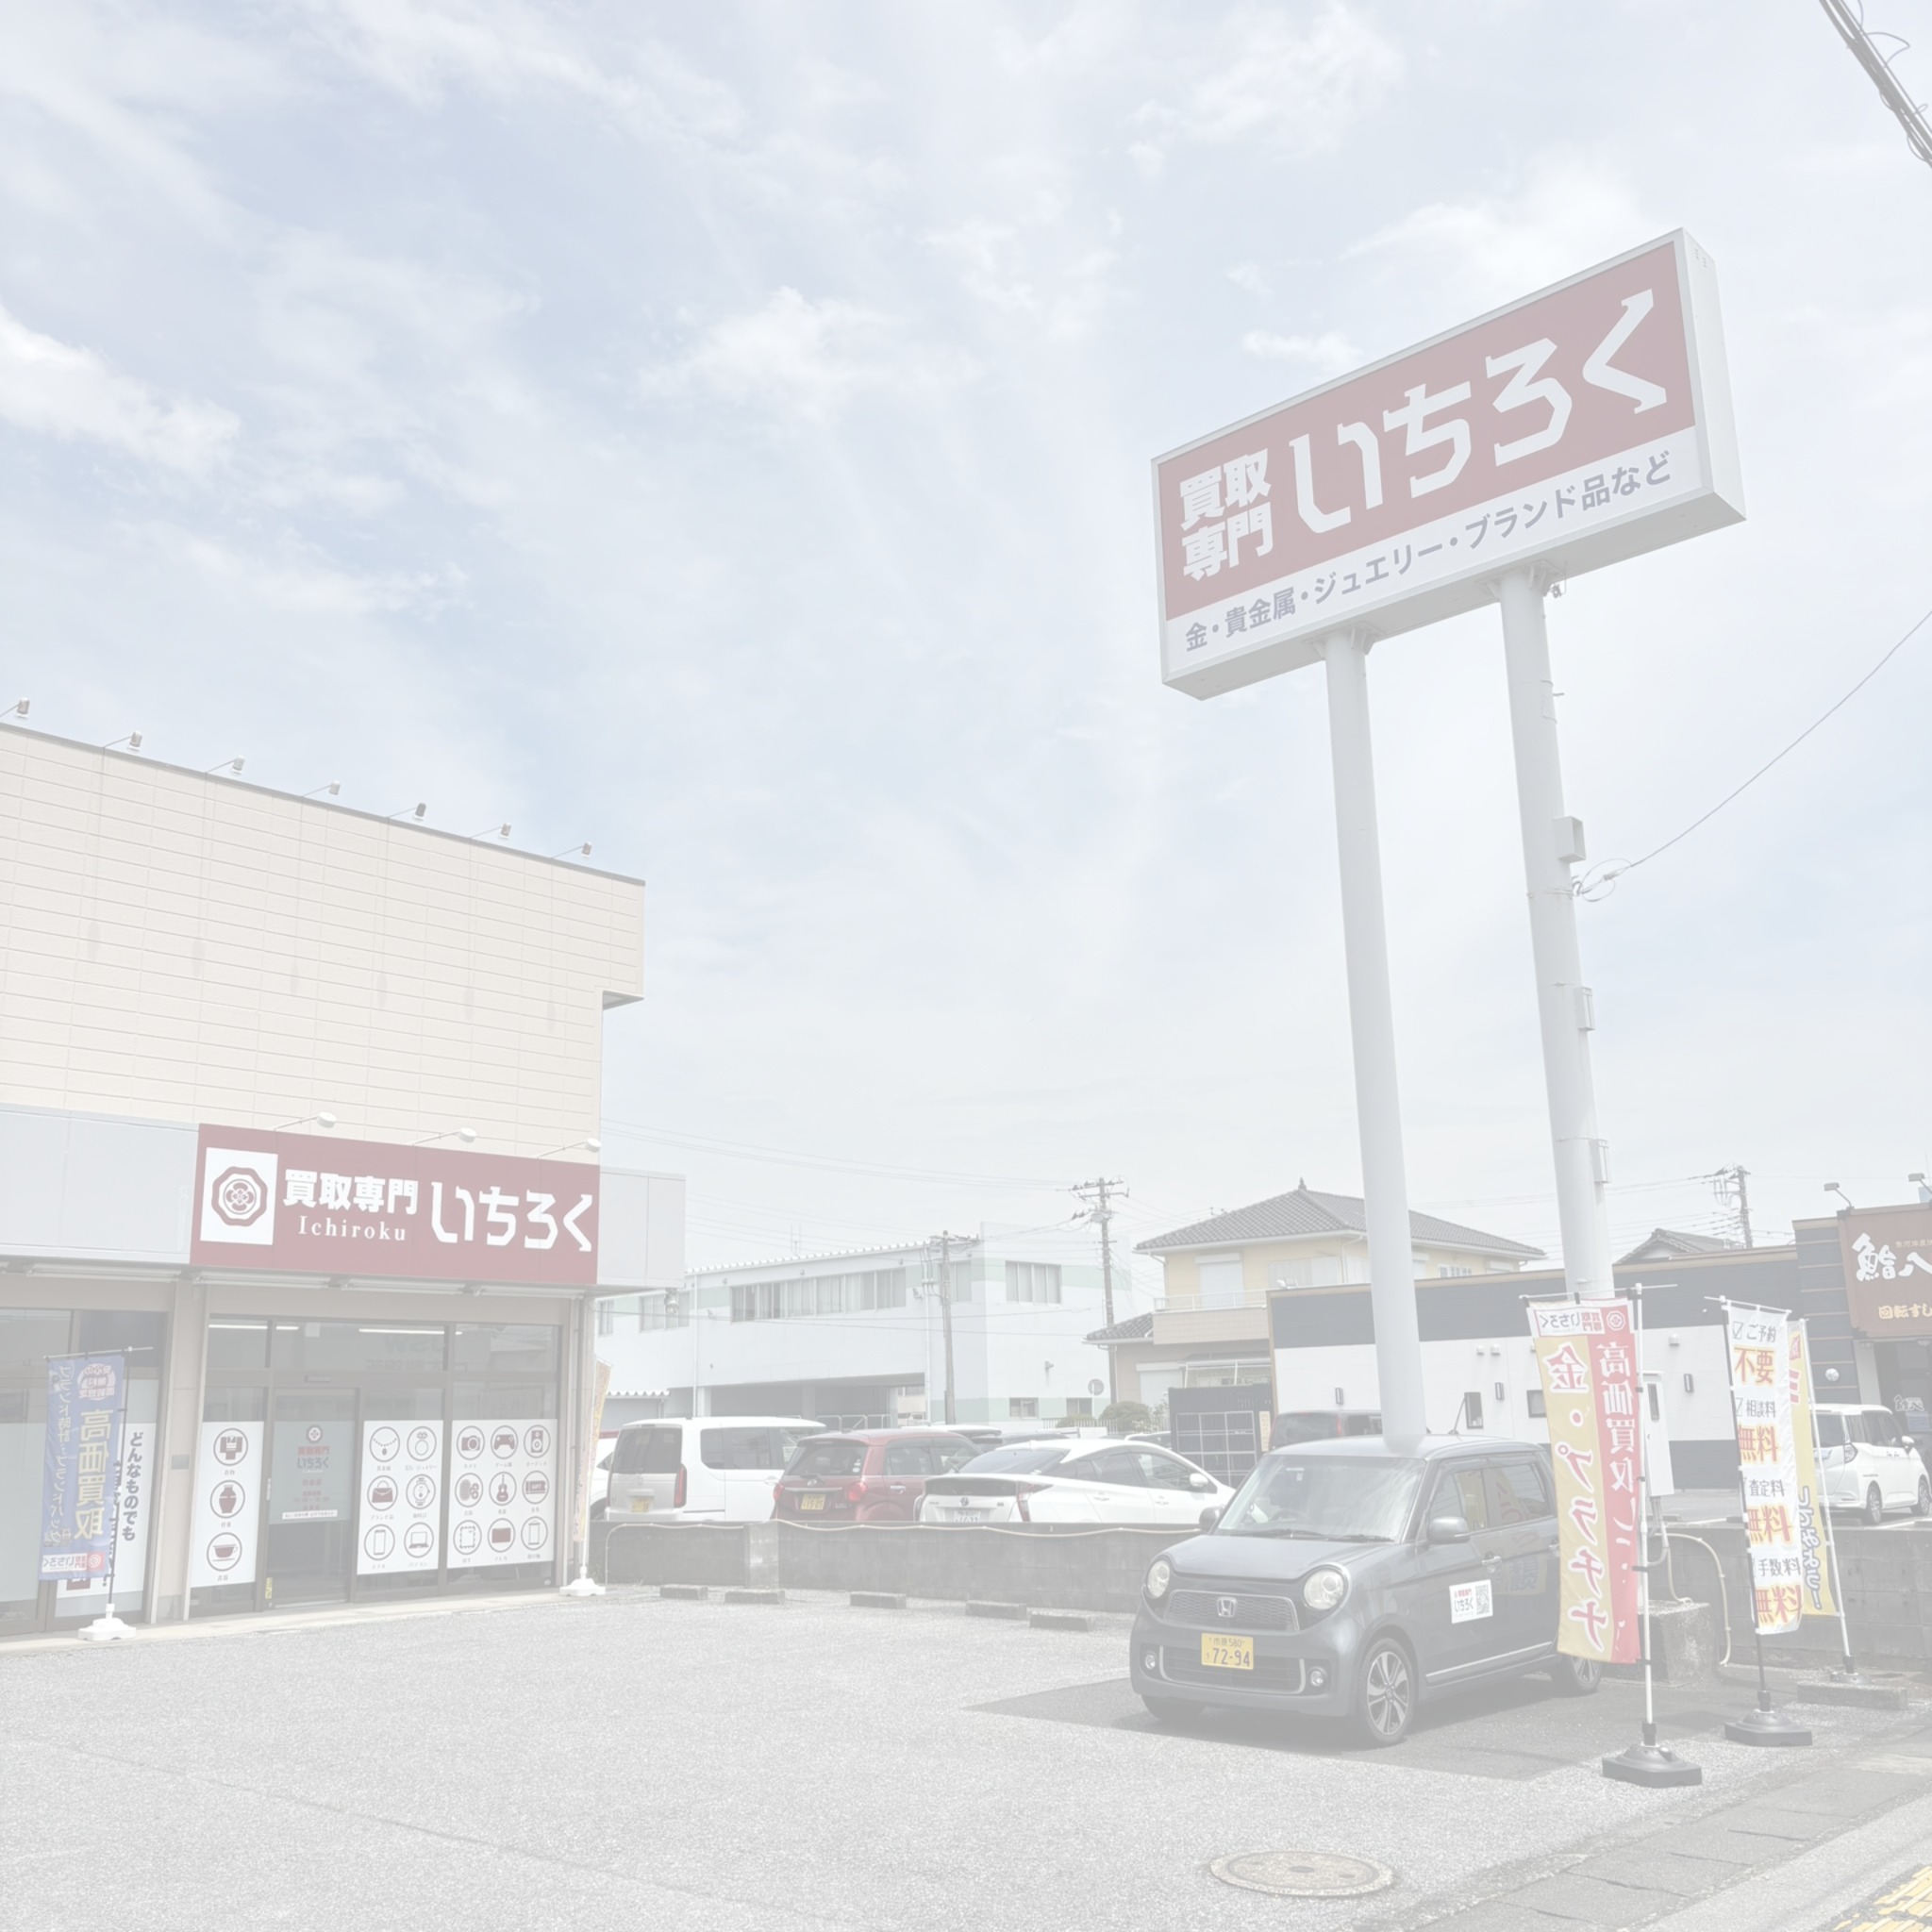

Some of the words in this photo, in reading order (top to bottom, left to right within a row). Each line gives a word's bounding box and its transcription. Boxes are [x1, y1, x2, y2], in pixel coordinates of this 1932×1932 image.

[1289, 288, 1668, 535] いちろく
[1179, 447, 1272, 531] 買取
[1182, 508, 1274, 582] 専門
[1184, 449, 1673, 653] 金・貴金属・ジュエリー・ブランド品など
[283, 1169, 419, 1216] 買取専門
[298, 1215, 407, 1242] Ichiroku
[431, 1181, 592, 1252] いちろく
[1878, 1303, 1932, 1320] 回転すし
[1746, 1323, 1777, 1343] ご予約
[1733, 1346, 1774, 1384] 不要
[1746, 1398, 1776, 1418] 相談料
[1738, 1423, 1779, 1462] 無料
[297, 1457, 330, 1469] いちろく
[122, 1431, 144, 1541] どんなものでも
[1749, 1478, 1786, 1497] 査定料
[1746, 1504, 1795, 1543] 無料
[1757, 1557, 1802, 1577] 手数料
[1756, 1584, 1803, 1624] 無料
[1212, 1647, 1251, 1668] 72-94
